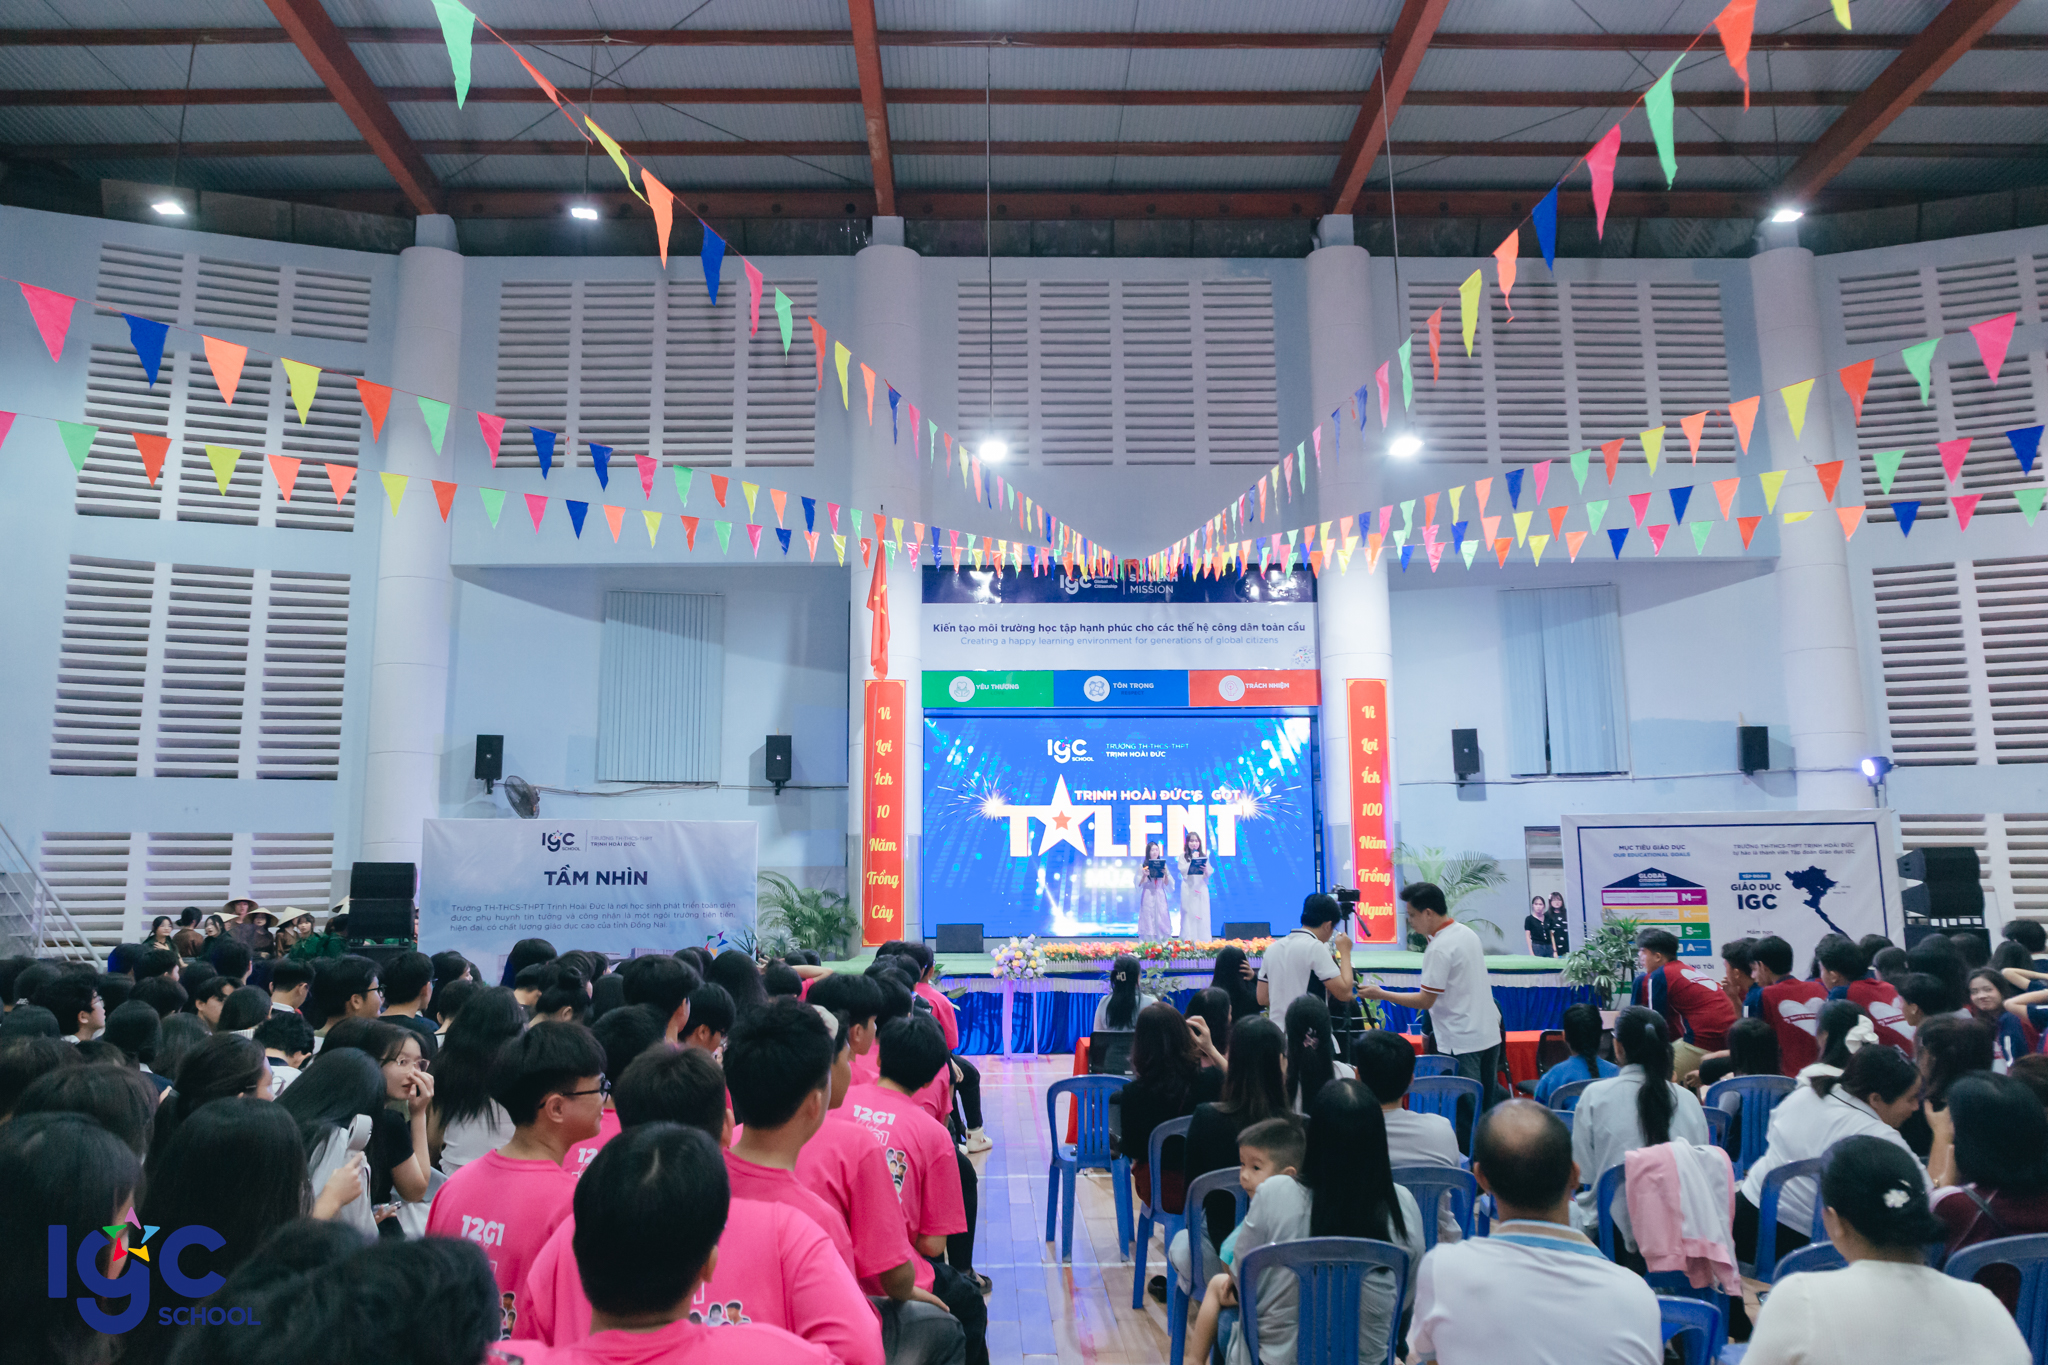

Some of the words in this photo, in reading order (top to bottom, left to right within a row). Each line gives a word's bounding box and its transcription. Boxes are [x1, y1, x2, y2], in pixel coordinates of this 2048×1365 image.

[1130, 585, 1174, 594] MISSION
[933, 622, 956, 632] Kiến
[959, 625, 975, 634] tạo
[978, 624, 998, 632] môi
[1001, 623, 1035, 634] trường
[1038, 624, 1056, 634] học
[1060, 624, 1076, 634] tập
[1080, 624, 1104, 634] hạnh
[1108, 623, 1132, 634] phúc
[1136, 623, 1154, 632] cho
[1157, 623, 1174, 632] các
[1178, 622, 1194, 632] thế
[1196, 623, 1208, 634] hệ
[1212, 623, 1236, 632] công
[1240, 623, 1258, 632] dân
[1262, 623, 1284, 632] toàn
[961, 637, 998, 646] Creating
[1008, 637, 1036, 646] happy
[1038, 637, 1074, 646] learning
[1077, 637, 1132, 645] environment
[1135, 636, 1148, 644] for
[1150, 636, 1202, 646] generations
[1204, 636, 1214, 644] of
[1216, 636, 1244, 646] global
[1246, 636, 1278, 644] citizens
[1268, 682, 1290, 690] NHIỆM
[878, 706, 892, 720] Vì
[1106, 751, 1128, 759] TRỊNH
[874, 768, 894, 787] Ích
[1362, 766, 1382, 784] Ích
[1074, 790, 1117, 803] TRỊNH
[1120, 788, 1156, 800] HOÀI
[1212, 790, 1241, 800] GOT
[876, 804, 890, 819] 10
[1362, 802, 1383, 817] 100
[869, 836, 898, 852] Năm
[1358, 836, 1388, 850] Năm
[544, 864, 588, 886] TẦM
[596, 866, 648, 886] NHÌN
[866, 868, 900, 890] Trồng
[1358, 867, 1391, 887] Trồng
[1730, 882, 1756, 891] GIÁO
[1760, 883, 1782, 893] DỤC
[452, 904, 482, 913] Trường
[548, 902, 568, 911] Trịnh
[590, 902, 606, 910] Đức
[630, 902, 644, 911] học
[664, 902, 680, 911] phát
[682, 901, 700, 909] triển
[720, 902, 736, 910] diện
[1737, 894, 1778, 910] IGC
[450, 914, 472, 922] được
[476, 914, 492, 922] phụ
[496, 914, 520, 922] huynh
[538, 913, 562, 921] tưởng
[634, 912, 650, 920] một
[654, 912, 670, 920] ngôi
[871, 904, 894, 923] Cây
[1358, 901, 1394, 920] Người
[520, 923, 542, 932] lượng
[544, 922, 562, 930] giáo
[564, 922, 578, 930] dục
[630, 920, 652, 930] Đồng
[853, 1104, 896, 1126] 12G1
[461, 1214, 505, 1246] 12G1
